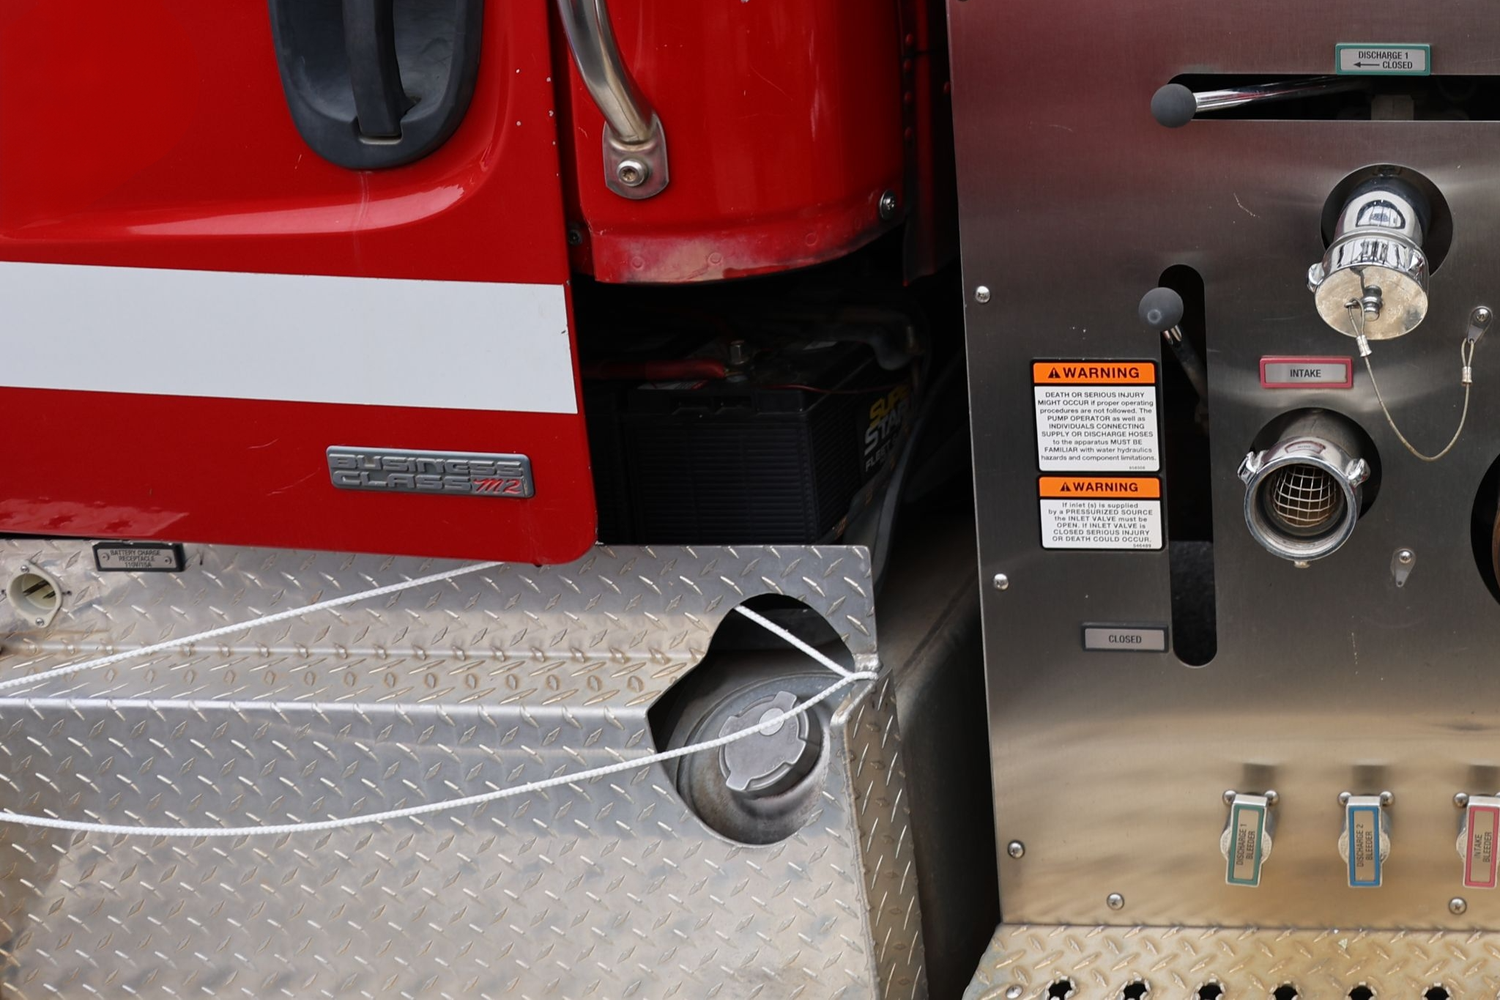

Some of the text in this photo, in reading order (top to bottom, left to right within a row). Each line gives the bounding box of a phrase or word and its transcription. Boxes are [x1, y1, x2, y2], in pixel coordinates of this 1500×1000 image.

[1358, 50, 1402, 60] DISCHARGE
[1382, 60, 1414, 70] CLOSED
[1063, 367, 1140, 378] WARNING
[1290, 369, 1321, 378] INTAKE
[329, 454, 523, 476] BUSINESS
[333, 471, 472, 491] CLASS
[1073, 483, 1138, 492] WARNING
[1108, 634, 1142, 644] CLOSED
[1236, 828, 1247, 865] DISCHARGE
[1246, 831, 1255, 860] BLEEDER
[1365, 831, 1373, 861] BLEEDER
[1474, 834, 1482, 858] INTAKE
[1483, 831, 1492, 862] BLEEDER
